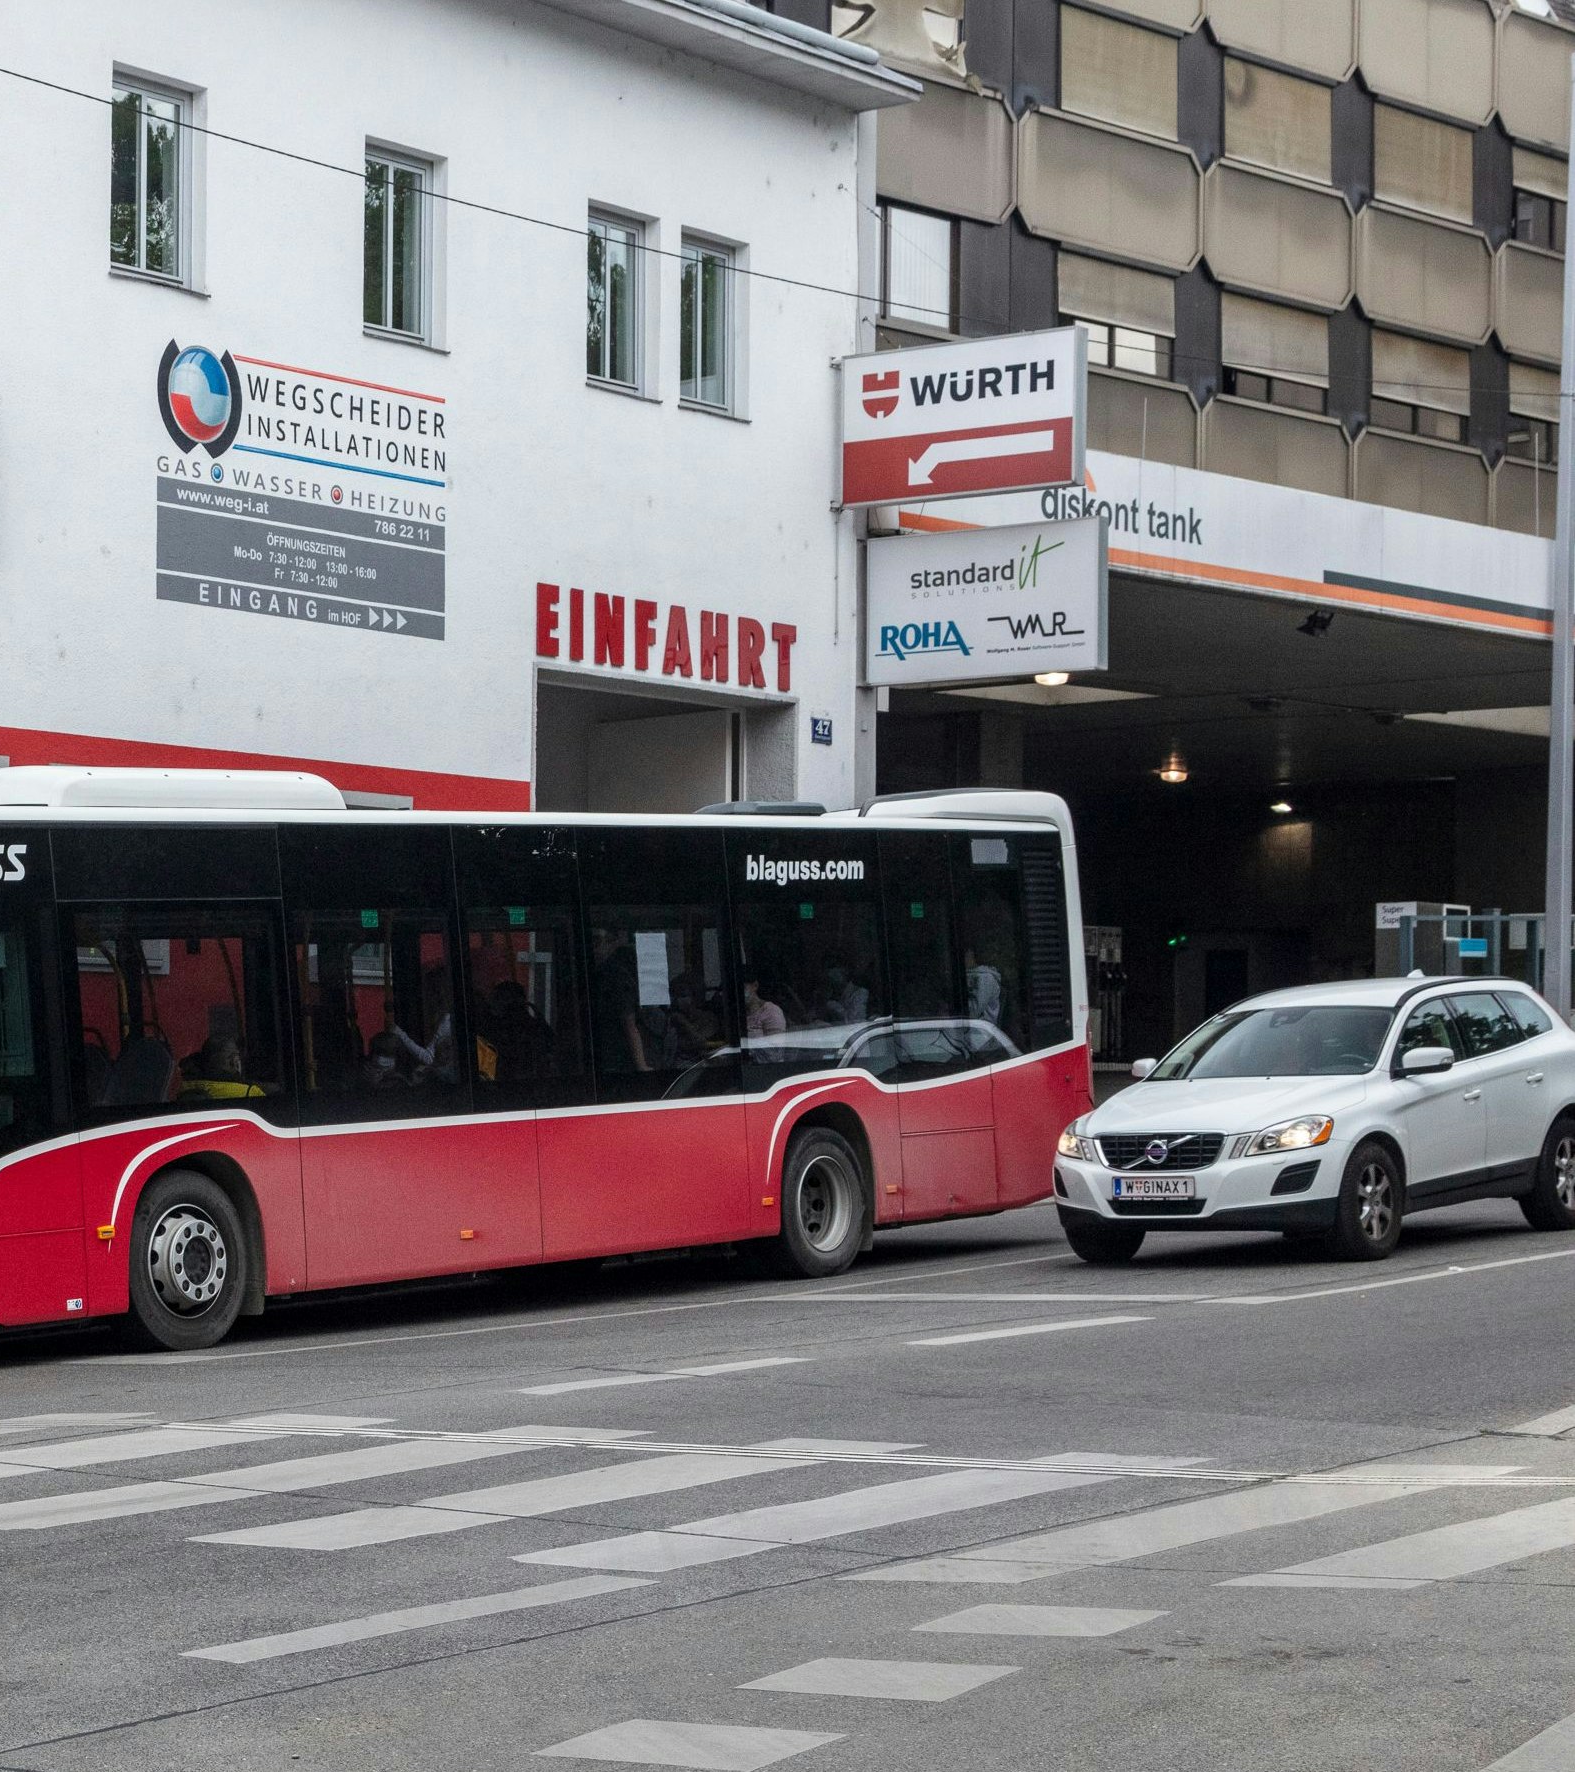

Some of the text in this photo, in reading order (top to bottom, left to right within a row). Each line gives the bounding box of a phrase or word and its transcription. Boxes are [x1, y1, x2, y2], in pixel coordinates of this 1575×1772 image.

[910, 359, 1055, 406] WÜRTH
[247, 373, 445, 438] WEGSCHEIDER
[248, 414, 445, 472] INSTALLATIONEN
[157, 455, 446, 522] GAS WASSER HEIZUNG
[177, 488, 269, 514] www.weg-i.at
[374, 520, 430, 541] 786 22 11
[1041, 487, 1203, 545] diskont tank
[234, 545, 263, 562] Mo-Do
[269, 551, 287, 565] 7:30
[294, 556, 317, 570] 12:00
[326, 561, 348, 575] 13:00
[355, 566, 377, 580] 16:00
[266, 532, 346, 558] ÖFFNUNGSZEITEN
[911, 534, 1064, 590] standard it
[275, 567, 284, 580] Fr
[290, 571, 309, 584] 7:30
[316, 575, 338, 589] 12:00
[911, 583, 1016, 599] SOLUTIONS
[199, 582, 361, 626] EINGANG im HOF
[536, 582, 797, 692] EINFAHRT
[881, 620, 971, 660] ROHA
[815, 720, 830, 735] 47
[746, 854, 864, 886] blaguss.com
[1382, 905, 1404, 914] Super
[1126, 1181, 1134, 1194] W
